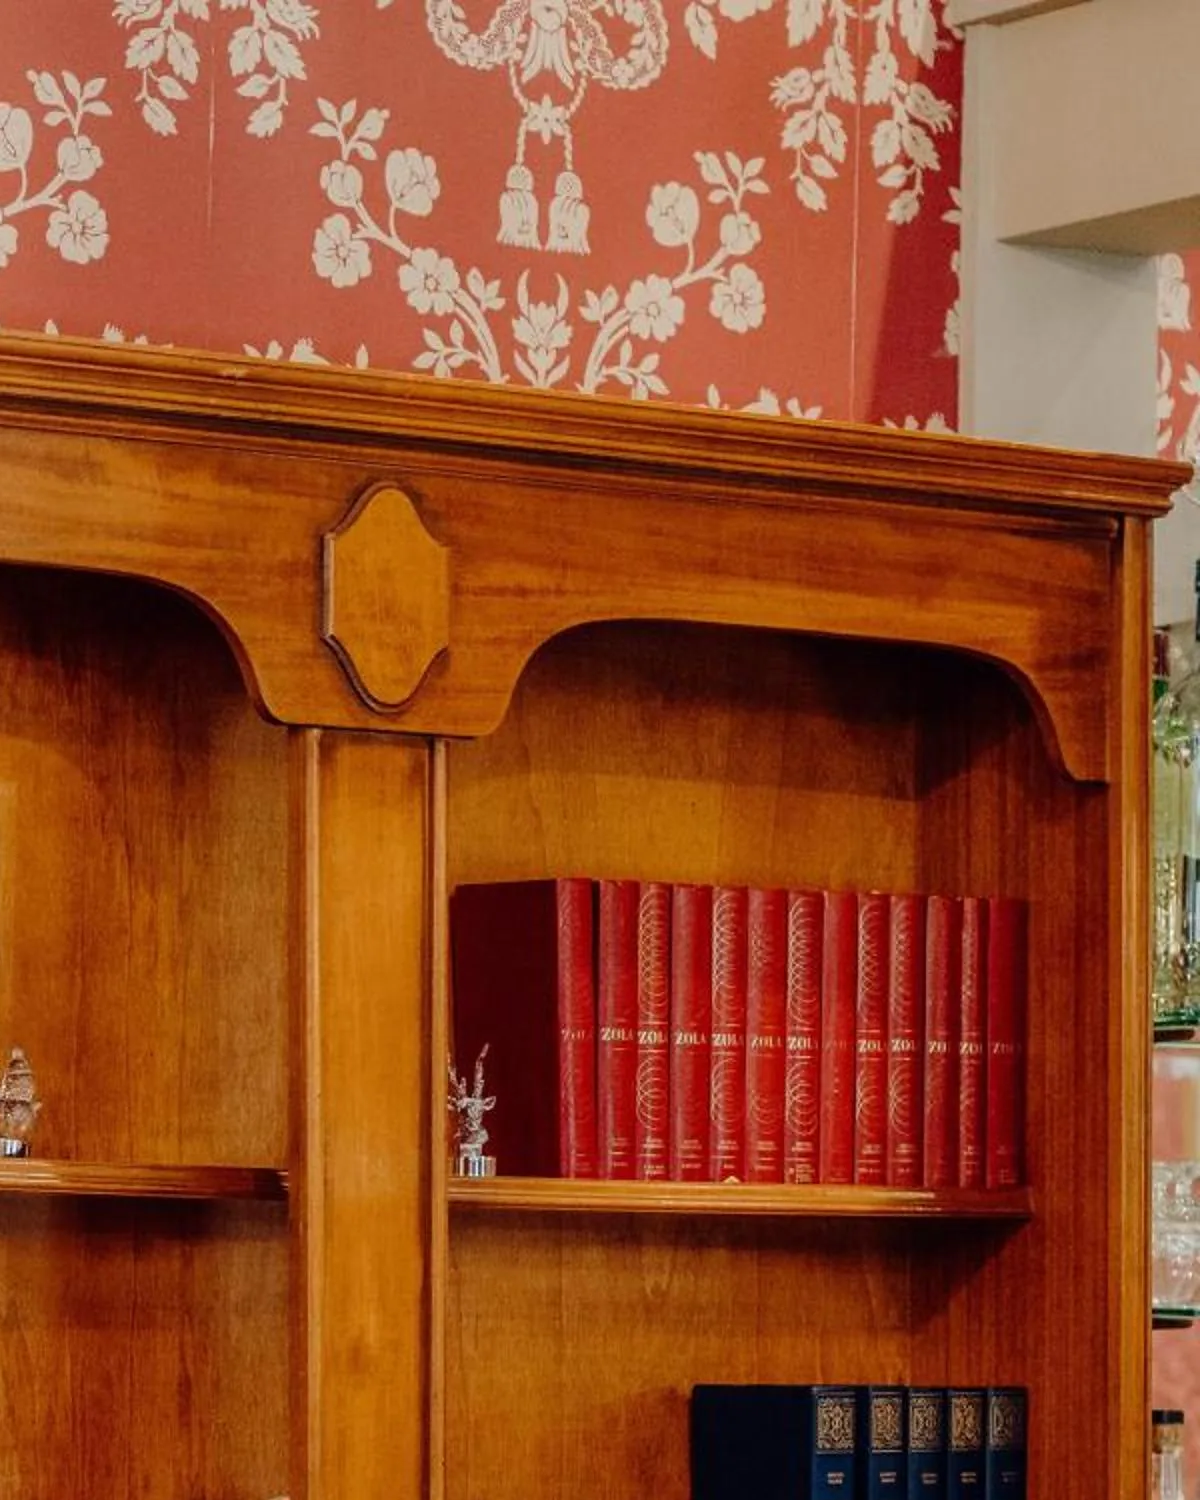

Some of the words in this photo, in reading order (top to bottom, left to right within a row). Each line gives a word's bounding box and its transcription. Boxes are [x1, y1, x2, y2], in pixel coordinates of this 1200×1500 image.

[601, 1027, 634, 1041] ZOLA
[675, 1031, 706, 1045] ZOLA
[751, 1036, 782, 1049] ZOLA
[857, 1039, 885, 1053] ZOL
[891, 1039, 916, 1053] ZOL
[927, 1040, 951, 1054] ZO
[960, 1041, 983, 1055] ZOL
